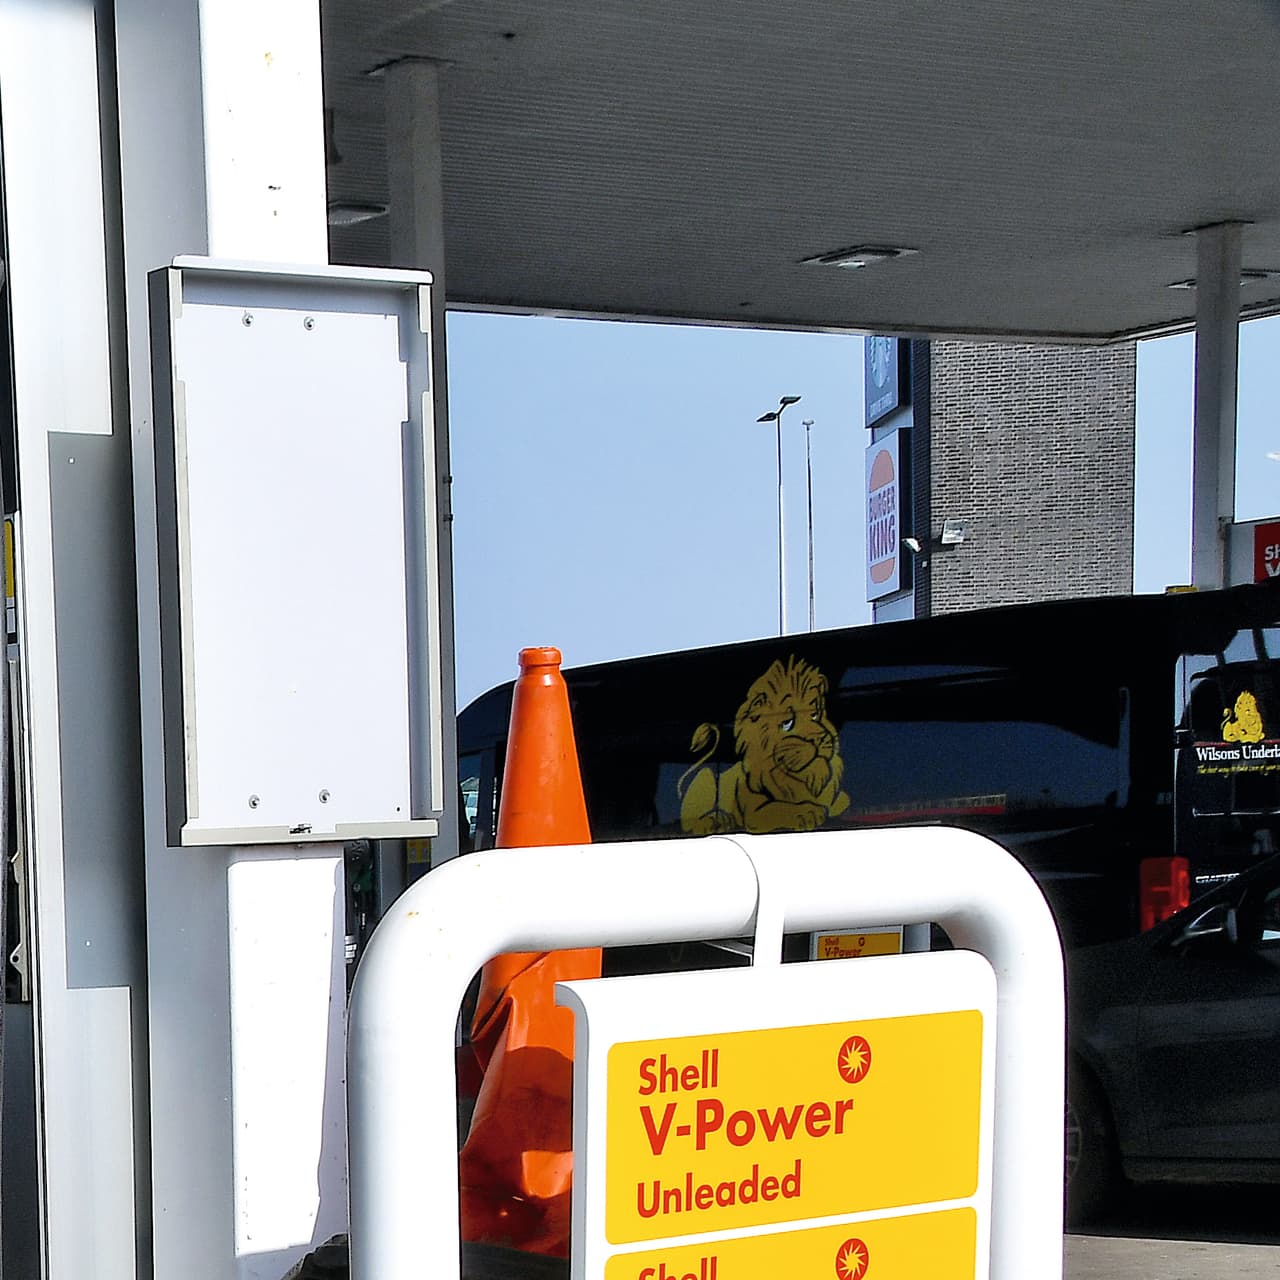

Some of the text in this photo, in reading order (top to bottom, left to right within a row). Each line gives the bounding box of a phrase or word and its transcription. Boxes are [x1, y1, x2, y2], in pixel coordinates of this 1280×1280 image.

[869, 486, 896, 523] BURGER
[869, 515, 896, 562] KING
[1196, 746, 1240, 761] Wilsons
[638, 1048, 720, 1096] Shell
[639, 1098, 854, 1156] V-Power
[636, 1159, 802, 1219] Unleaded
